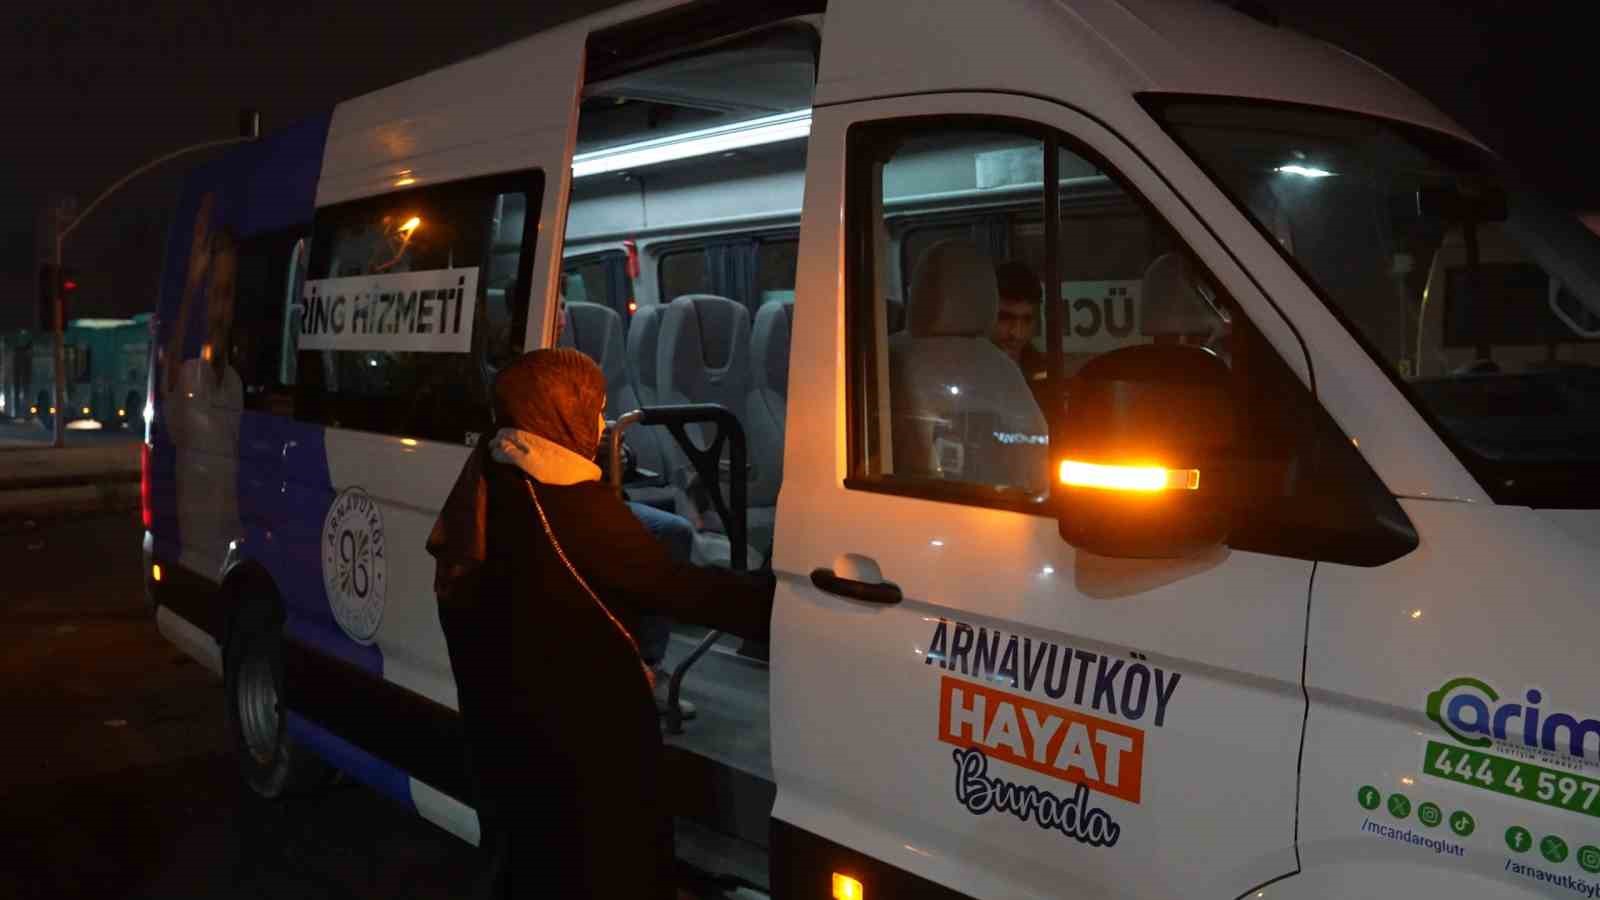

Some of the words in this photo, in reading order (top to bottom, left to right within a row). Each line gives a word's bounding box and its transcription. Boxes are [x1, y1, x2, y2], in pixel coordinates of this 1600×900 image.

[925, 617, 1181, 727] ARNAVUTKÖY
[949, 687, 1134, 788] HAYAT
[1434, 748, 1495, 786] 444
[1504, 765, 1524, 793] 4
[1535, 773, 1600, 811] 597
[953, 747, 1121, 848] Burada
[1361, 818, 1465, 857] /mcandaroglutr
